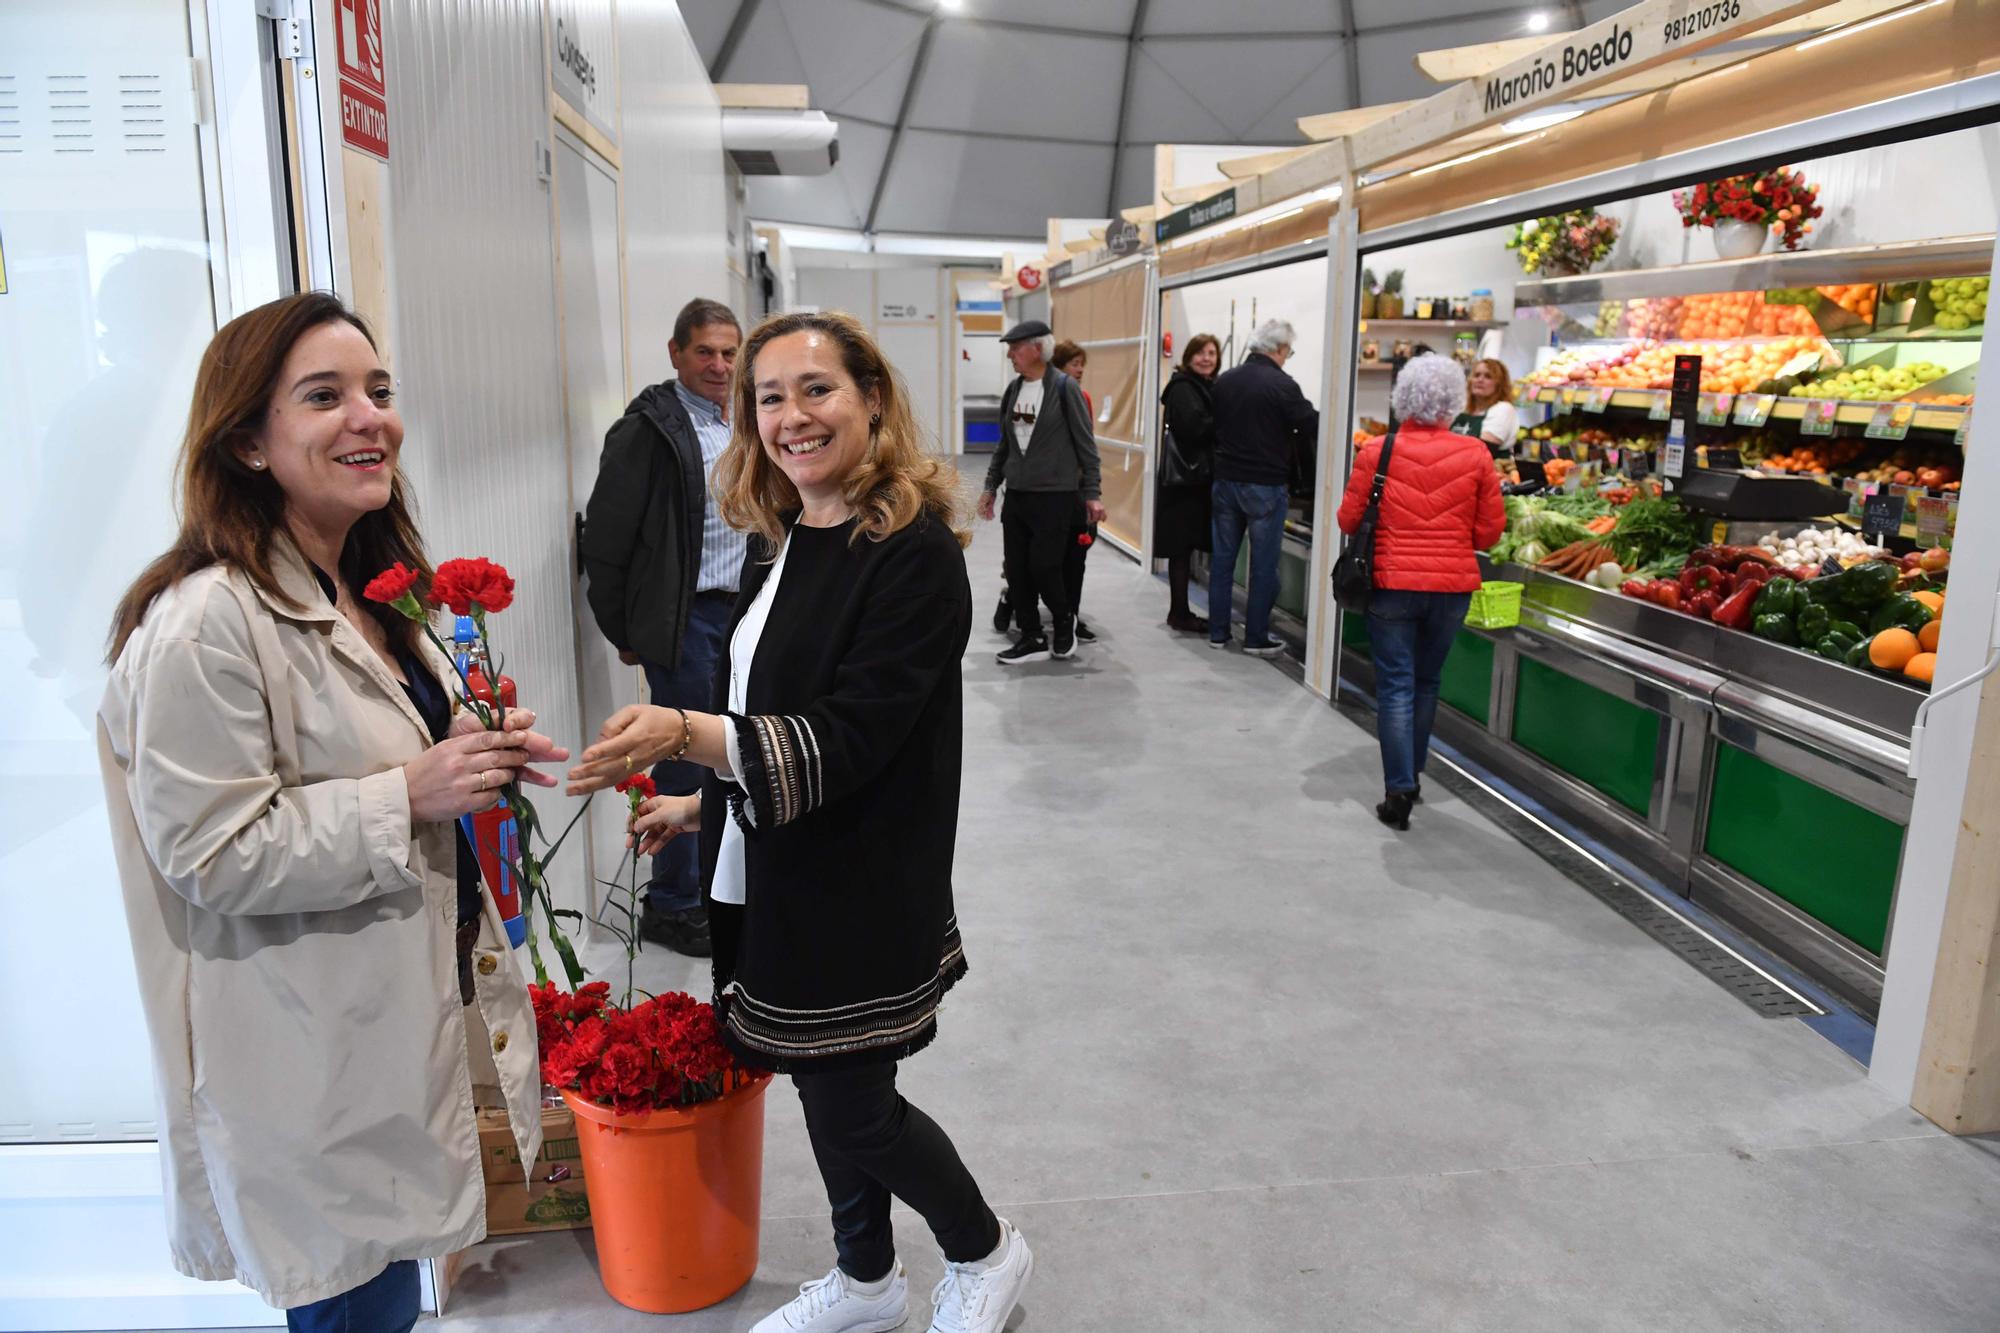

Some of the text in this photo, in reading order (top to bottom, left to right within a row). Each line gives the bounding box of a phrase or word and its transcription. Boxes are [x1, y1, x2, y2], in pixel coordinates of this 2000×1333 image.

[1484, 0, 1741, 113] Maroño Boedo 981210736
[343, 94, 387, 143] EXTINTOR
